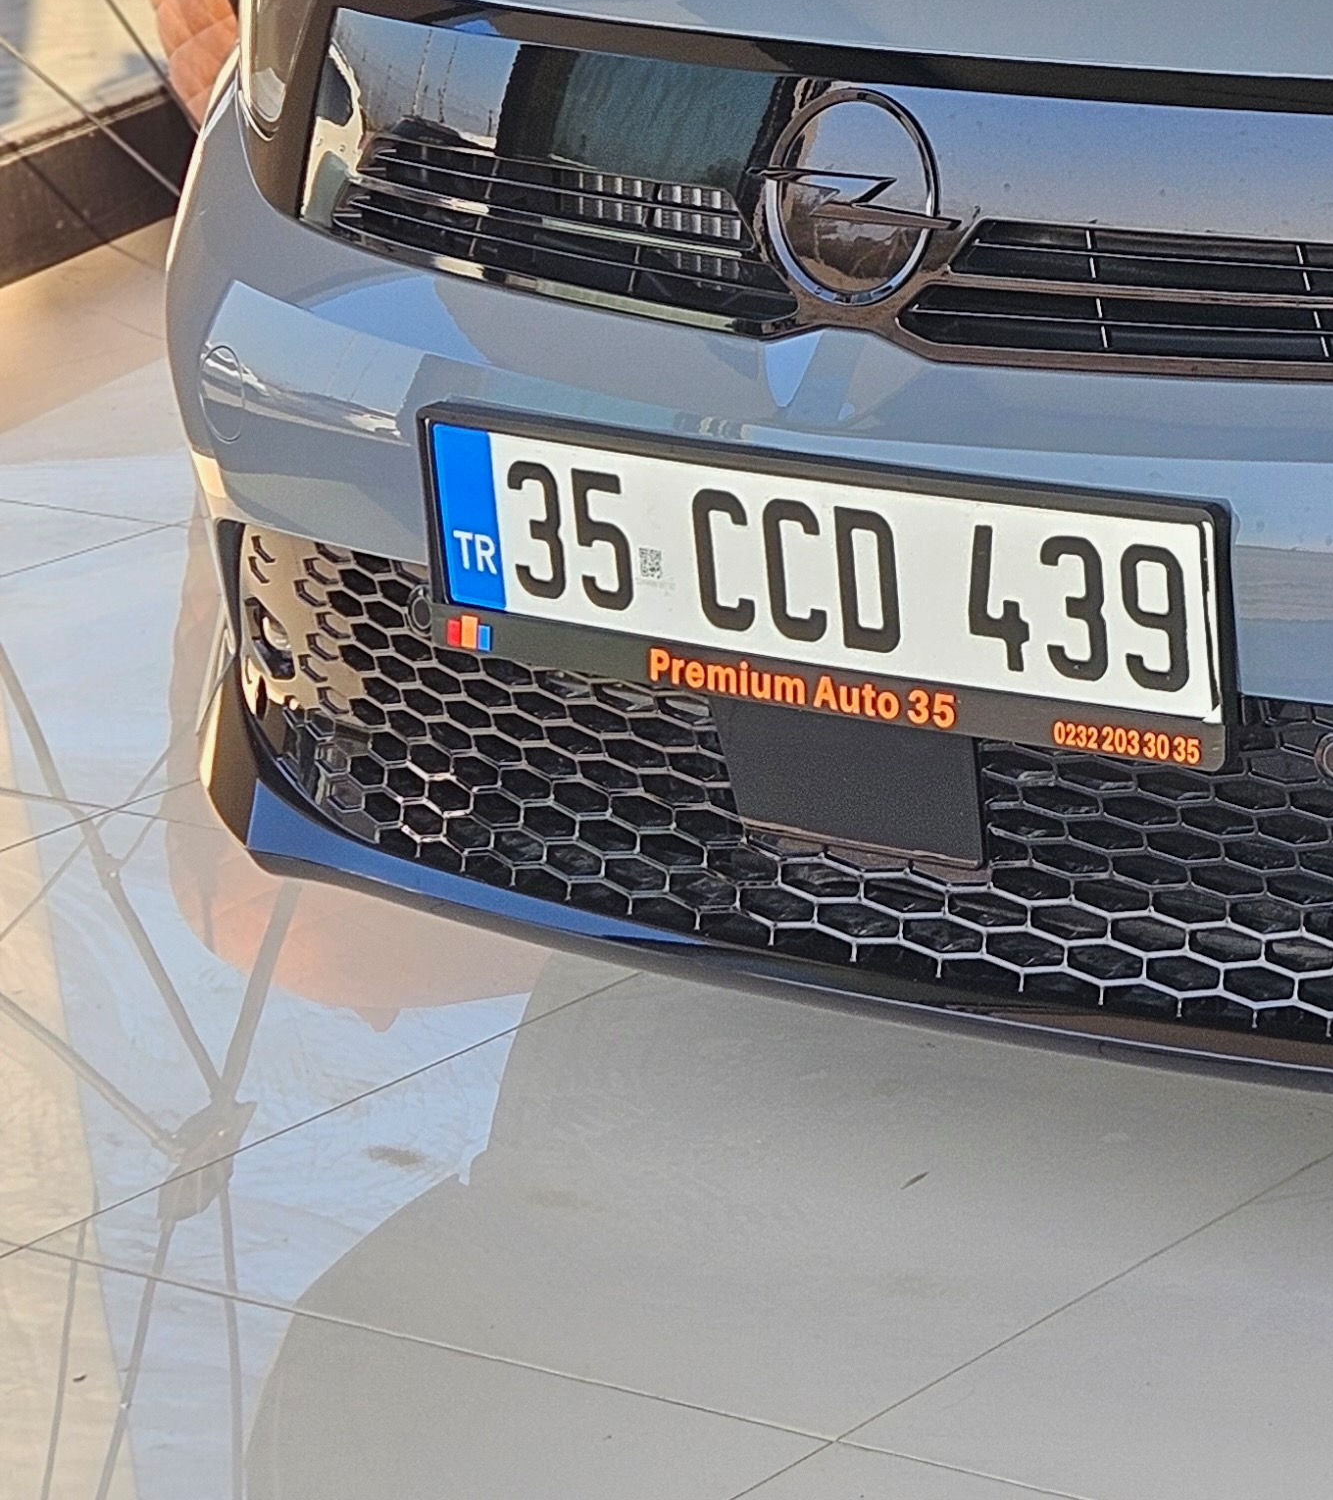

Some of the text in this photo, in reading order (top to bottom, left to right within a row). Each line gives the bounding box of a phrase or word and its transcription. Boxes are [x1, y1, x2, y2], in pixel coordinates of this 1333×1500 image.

[453, 530, 497, 575] TR
[507, 460, 1190, 693] 35 CCD 439
[650, 647, 956, 729] Premium Auto 35
[1054, 721, 1201, 764] 0232 203 30 35
